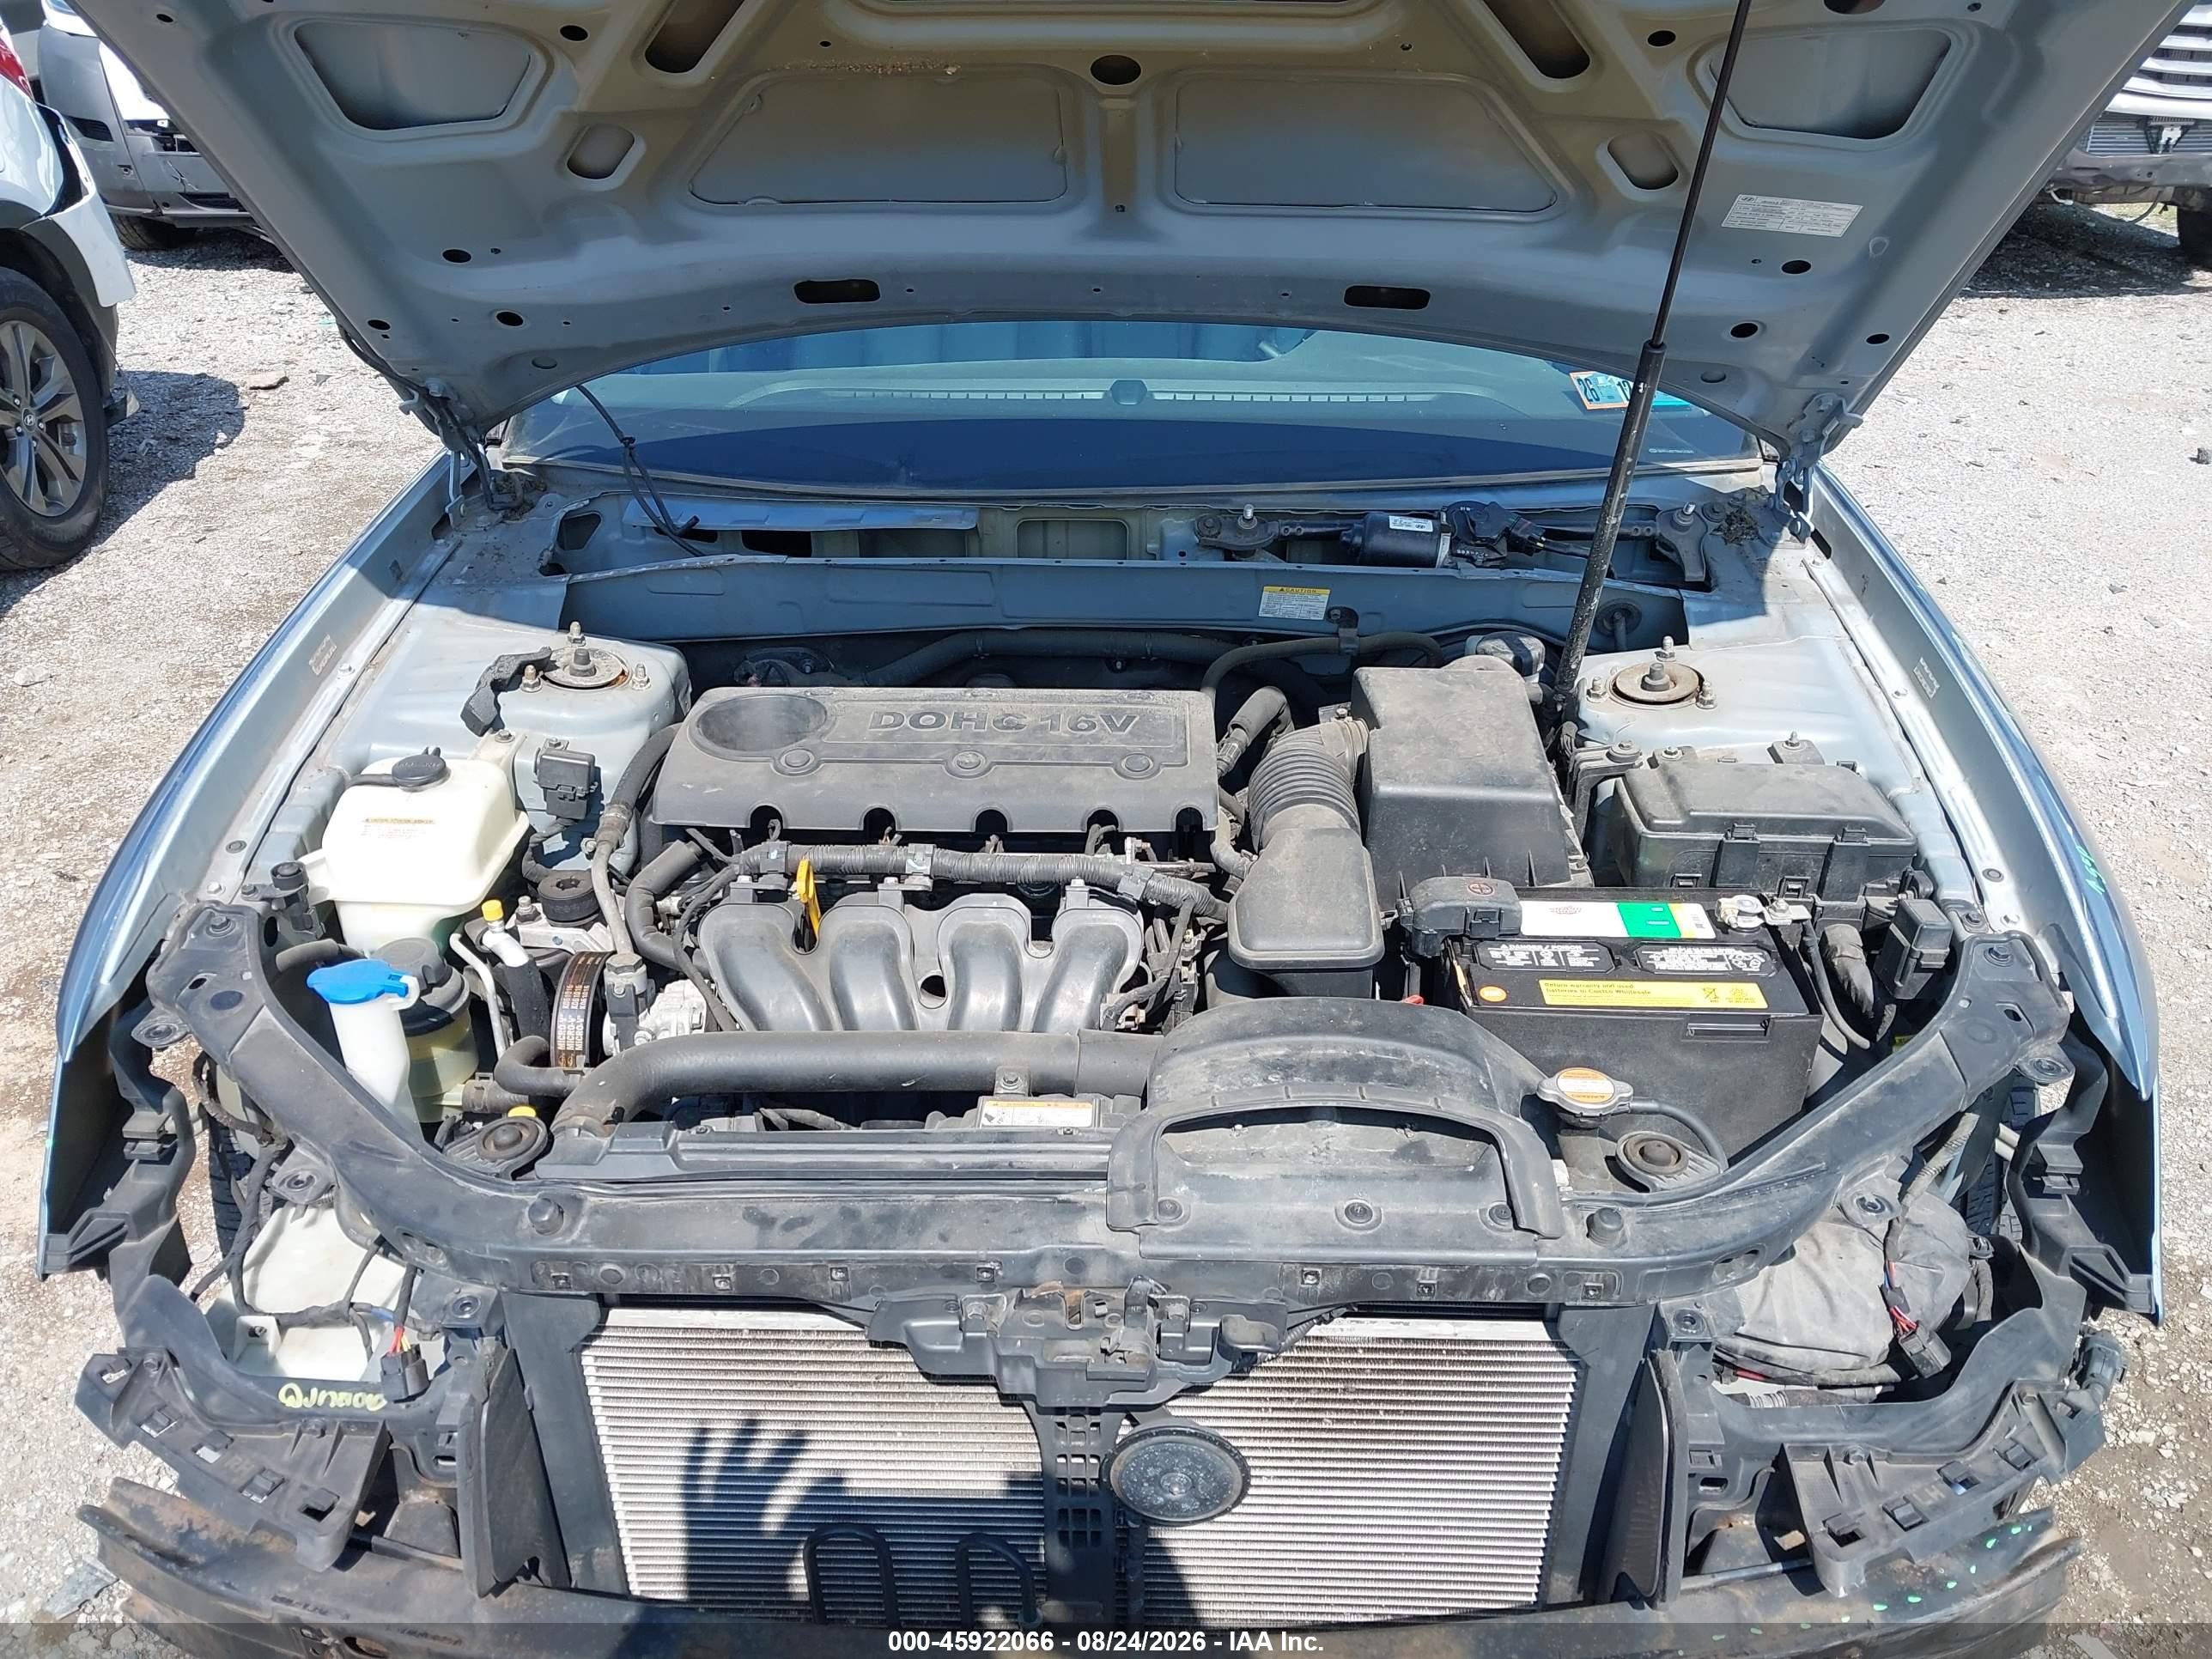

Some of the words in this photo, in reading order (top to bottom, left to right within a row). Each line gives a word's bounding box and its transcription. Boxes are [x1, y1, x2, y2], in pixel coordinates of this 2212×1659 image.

[1577, 378, 1601, 403] 26
[868, 710, 1029, 733] DOHC
[1038, 713, 1140, 735] 16V
